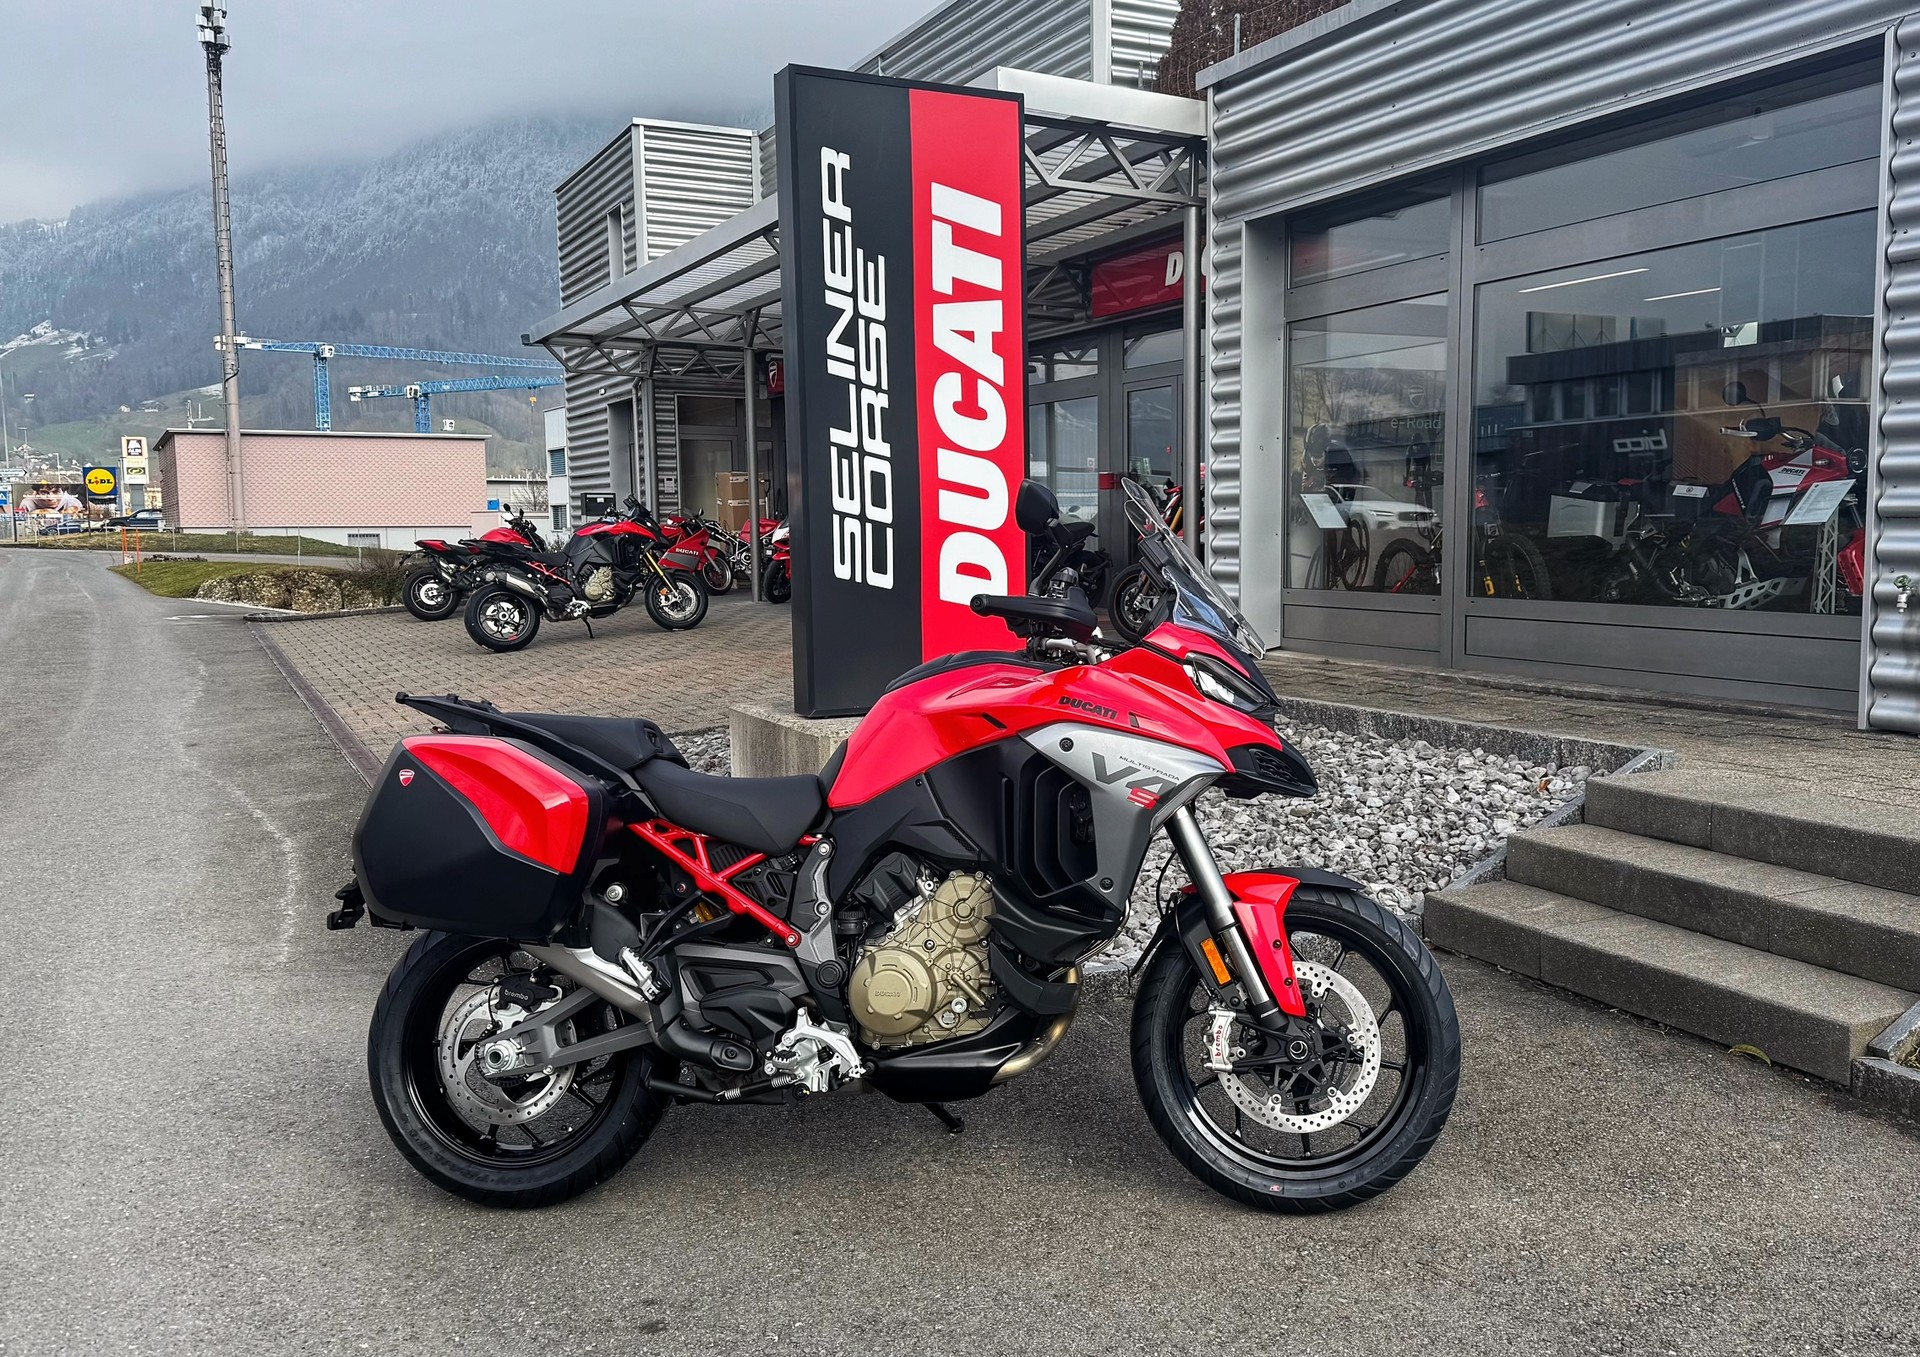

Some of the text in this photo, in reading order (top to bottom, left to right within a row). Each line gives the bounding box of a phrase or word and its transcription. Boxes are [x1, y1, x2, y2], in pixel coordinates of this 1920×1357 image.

[820, 145, 863, 583] SELINER
[930, 181, 1009, 606] DUCATI
[857, 246, 895, 591] CORSE
[1390, 416, 1442, 430] e-Road
[1781, 467, 1806, 475] DUCATI
[675, 548, 699, 556] DUCATI
[1058, 696, 1117, 720] DUCATI
[1119, 755, 1180, 781] MULTISTRADA
[1126, 787, 1161, 810] S
[503, 989, 529, 1001] brembo
[1214, 1024, 1223, 1057] brembo
